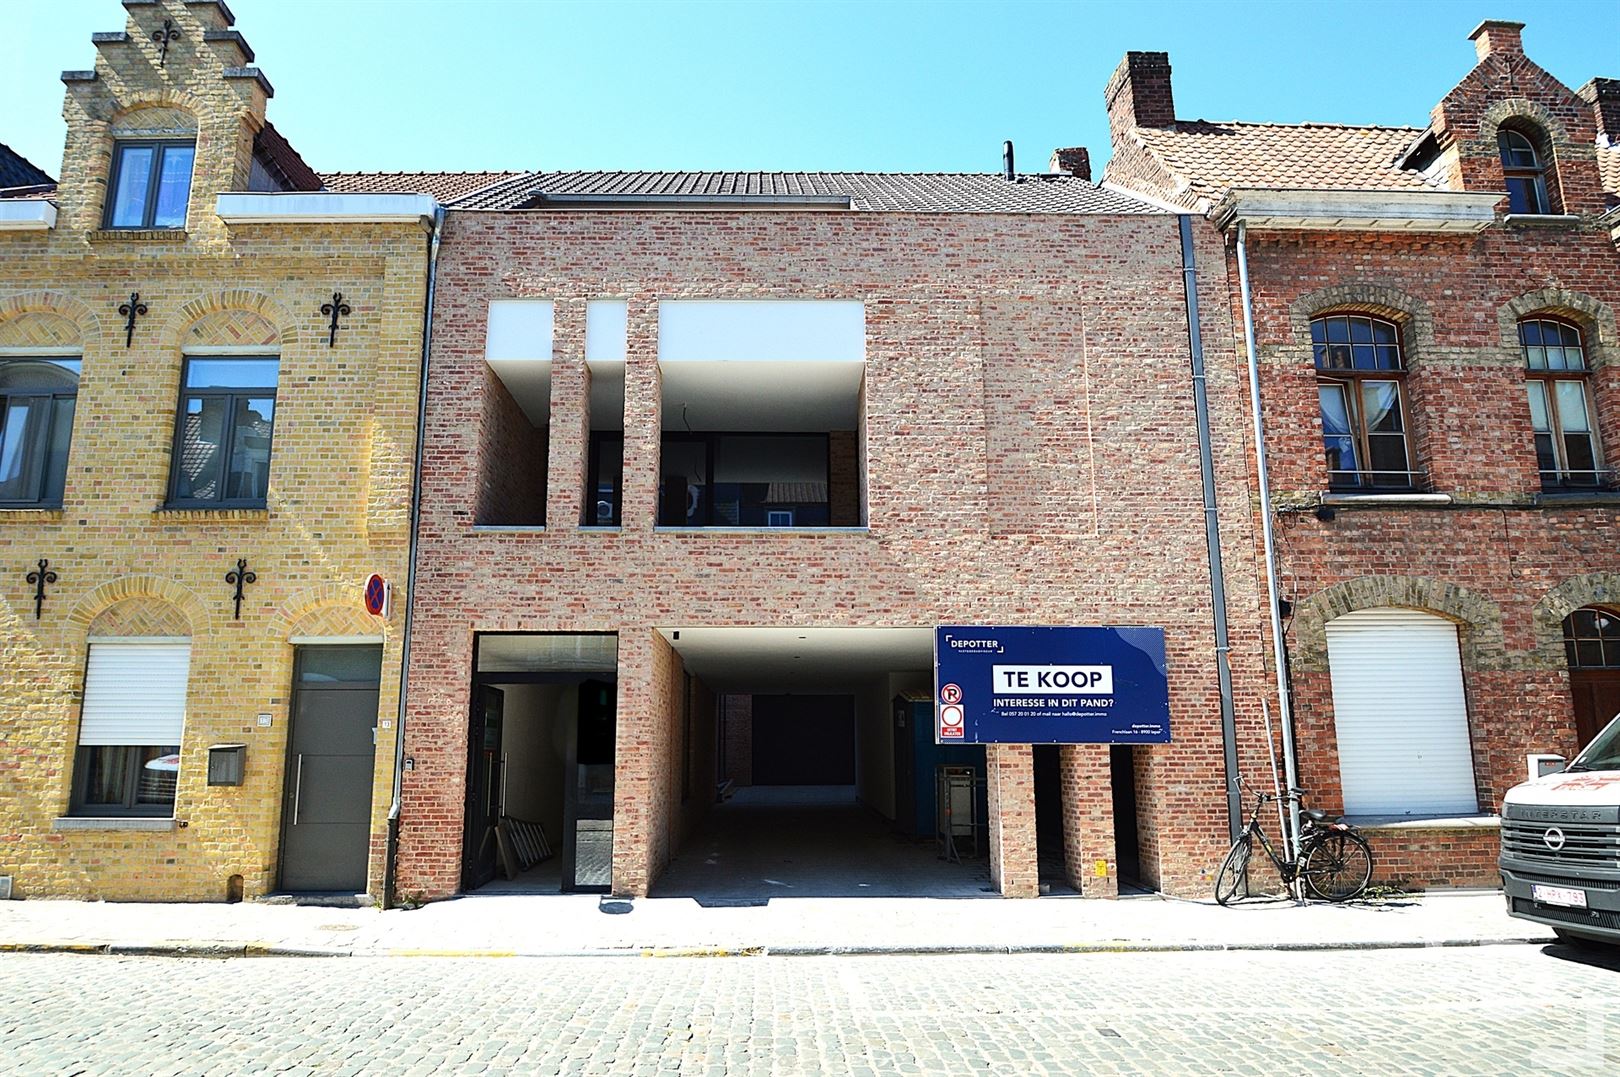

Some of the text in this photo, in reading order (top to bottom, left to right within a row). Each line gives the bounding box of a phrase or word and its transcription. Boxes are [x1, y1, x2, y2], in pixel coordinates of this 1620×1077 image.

[1003, 671, 1102, 688] TE KOOP
[994, 698, 1114, 707] INTERESSE IN DIT PAND?
[1521, 808, 1601, 820] INTERSTAR
